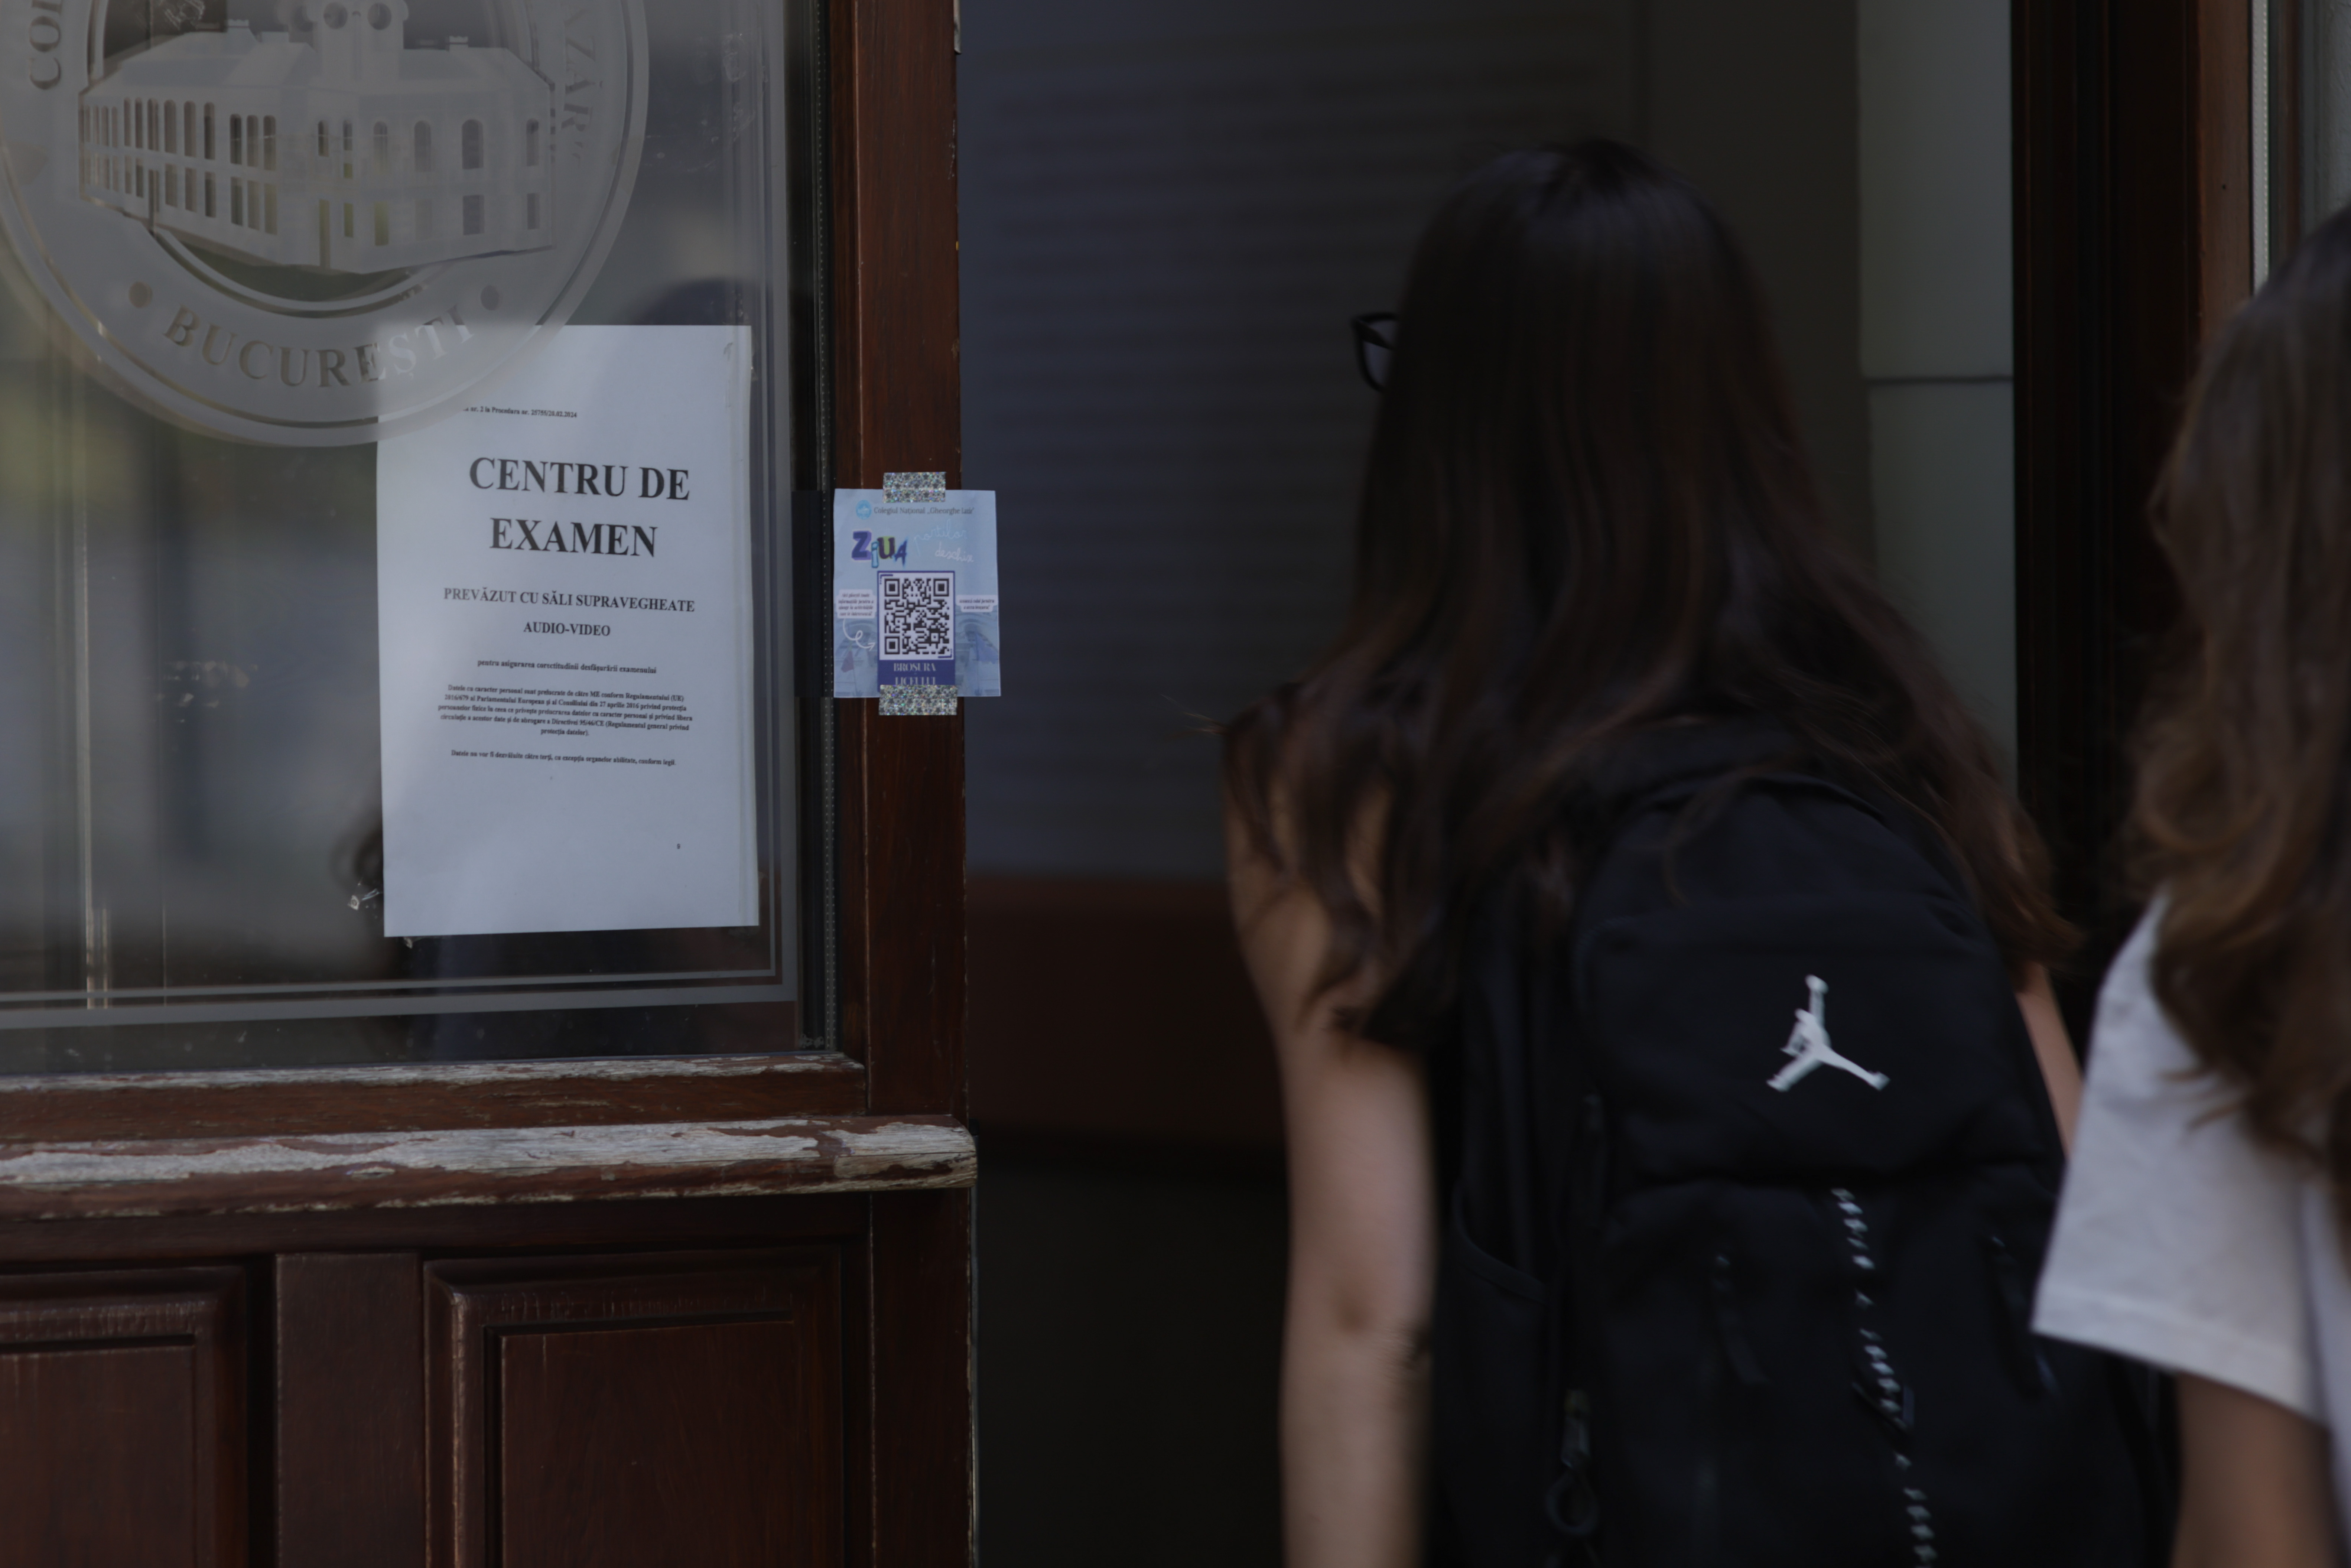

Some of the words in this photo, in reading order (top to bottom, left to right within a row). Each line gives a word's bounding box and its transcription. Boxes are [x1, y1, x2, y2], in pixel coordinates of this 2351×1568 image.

[163, 303, 475, 388] BUCUREȘTI
[469, 457, 629, 497] CENTRU
[638, 467, 690, 500] DE
[874, 507, 898, 515] Colegiul
[490, 518, 658, 557] EXAMEN
[445, 587, 516, 602] PREVĂZUT
[520, 592, 539, 604] CU
[542, 591, 572, 605] SĂLI
[576, 595, 695, 612] SUPRAVEGHEATE
[523, 622, 611, 636] AUDIO-VIDEO
[501, 660, 535, 669] asigurarea
[517, 697, 545, 706] European
[625, 693, 670, 701] Regulamentului
